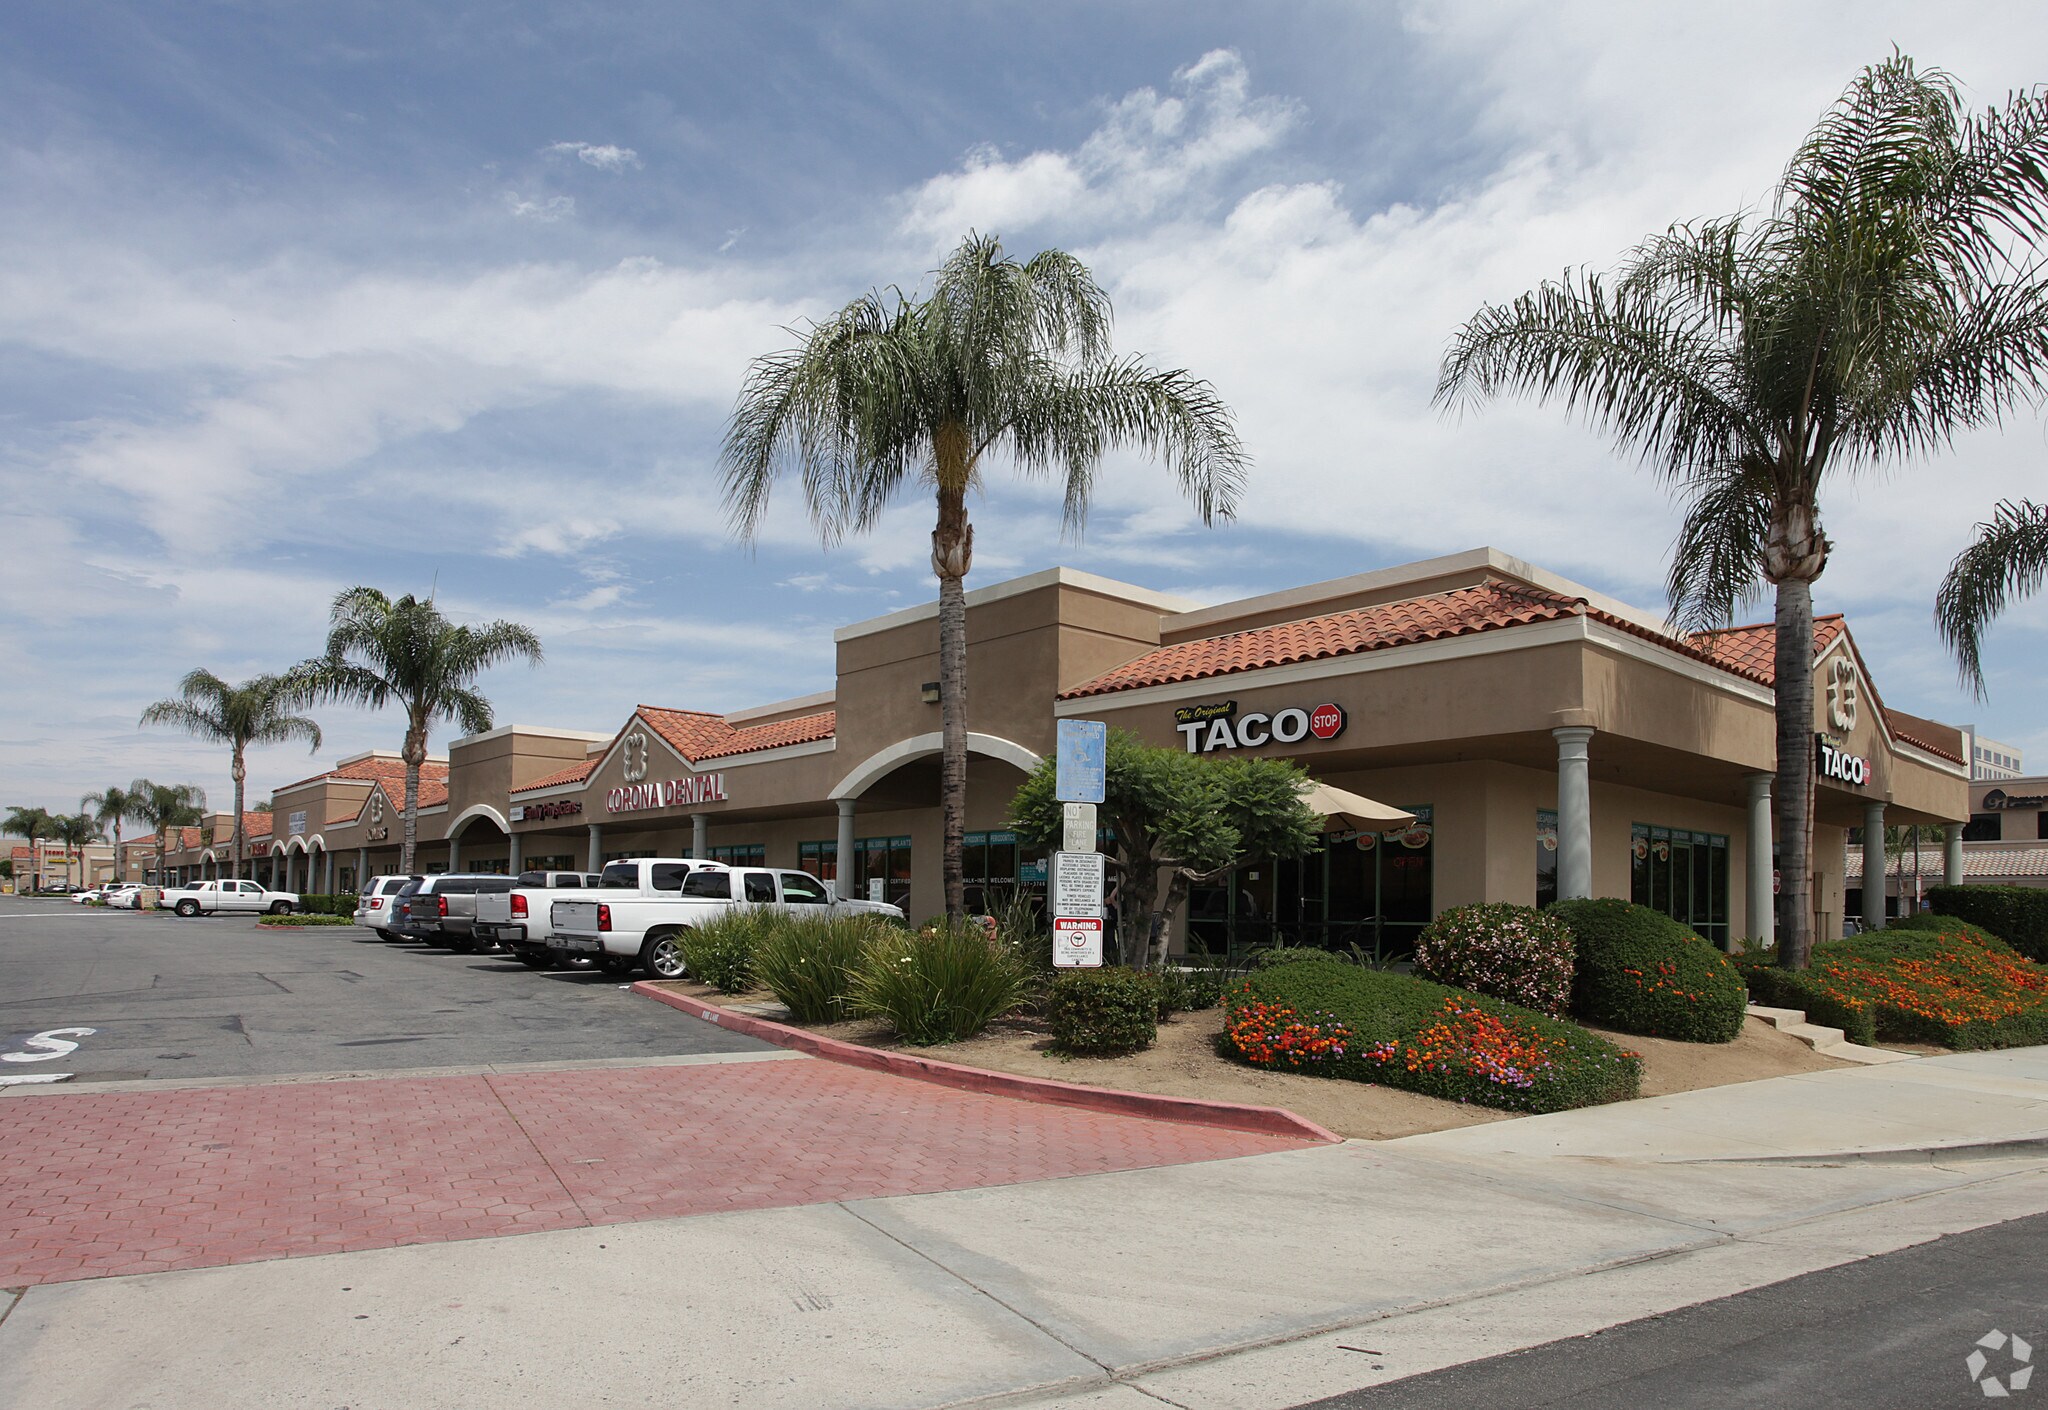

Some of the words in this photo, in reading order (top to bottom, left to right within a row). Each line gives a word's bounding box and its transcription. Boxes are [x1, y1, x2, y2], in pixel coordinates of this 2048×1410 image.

[1176, 709, 1192, 720] The
[1194, 702, 1231, 719] Original
[1314, 714, 1338, 729] STOP
[1176, 708, 1309, 753] TACO
[1822, 745, 1864, 784] TACO
[607, 783, 661, 813] CORONA
[665, 773, 727, 806] DENTAL
[1066, 805, 1078, 817] NO
[1065, 819, 1095, 830] PARKING
[1073, 830, 1087, 839] FIRE
[890, 838, 911, 847] IMPLANTS
[1071, 838, 1088, 847] LANE
[1393, 856, 1425, 869] OPEN
[1060, 921, 1097, 930] WARNING
